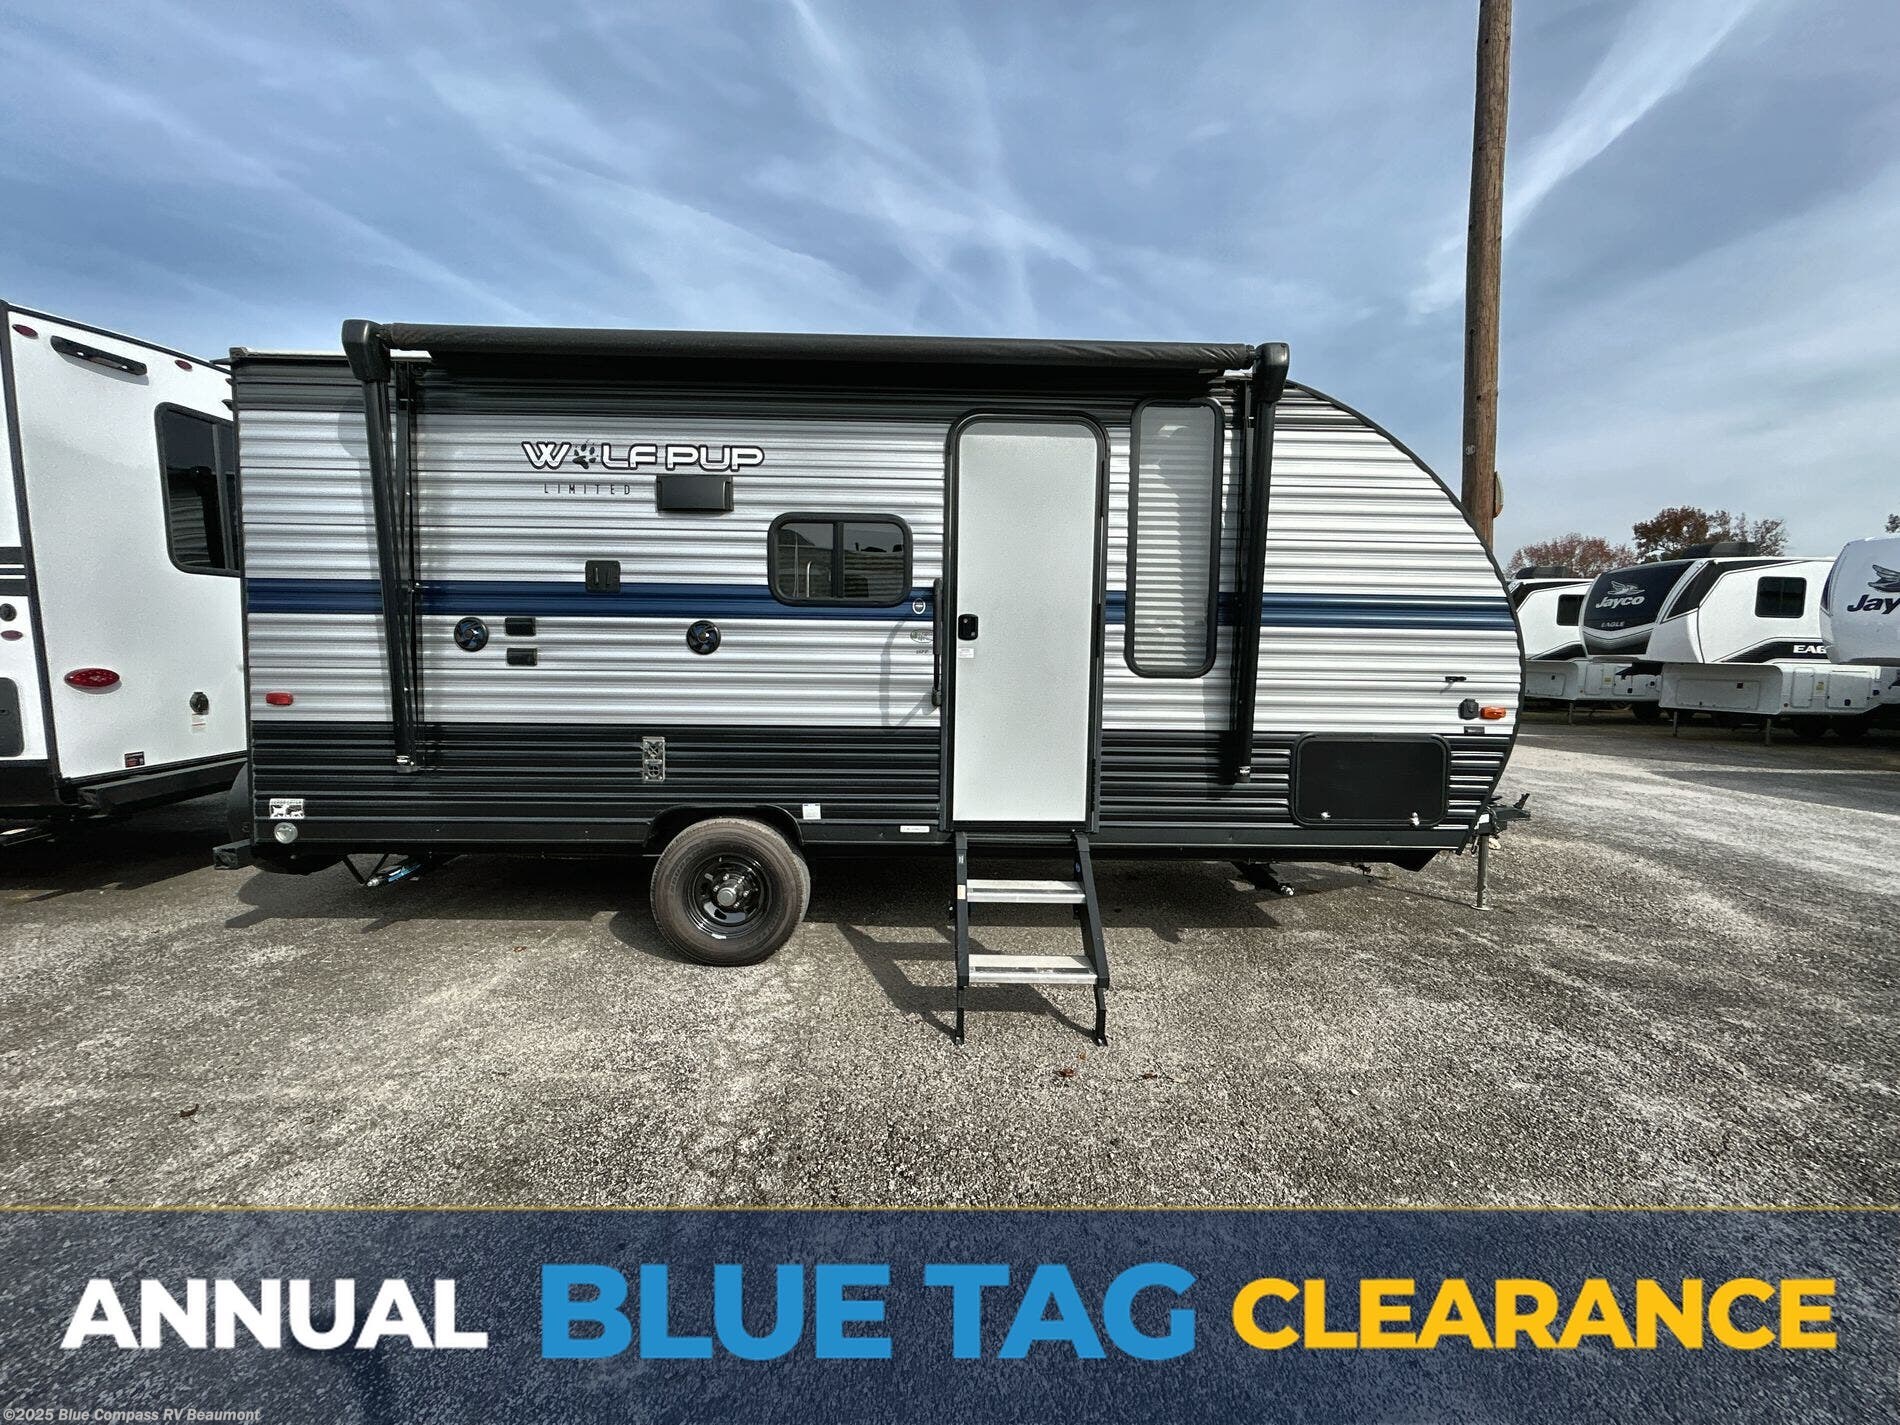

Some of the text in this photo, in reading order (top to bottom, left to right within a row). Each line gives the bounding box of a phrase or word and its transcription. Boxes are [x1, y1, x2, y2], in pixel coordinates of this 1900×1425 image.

[665, 443, 765, 472] PUP
[543, 483, 631, 495] LIMITED
[1595, 596, 1645, 609] Jayco
